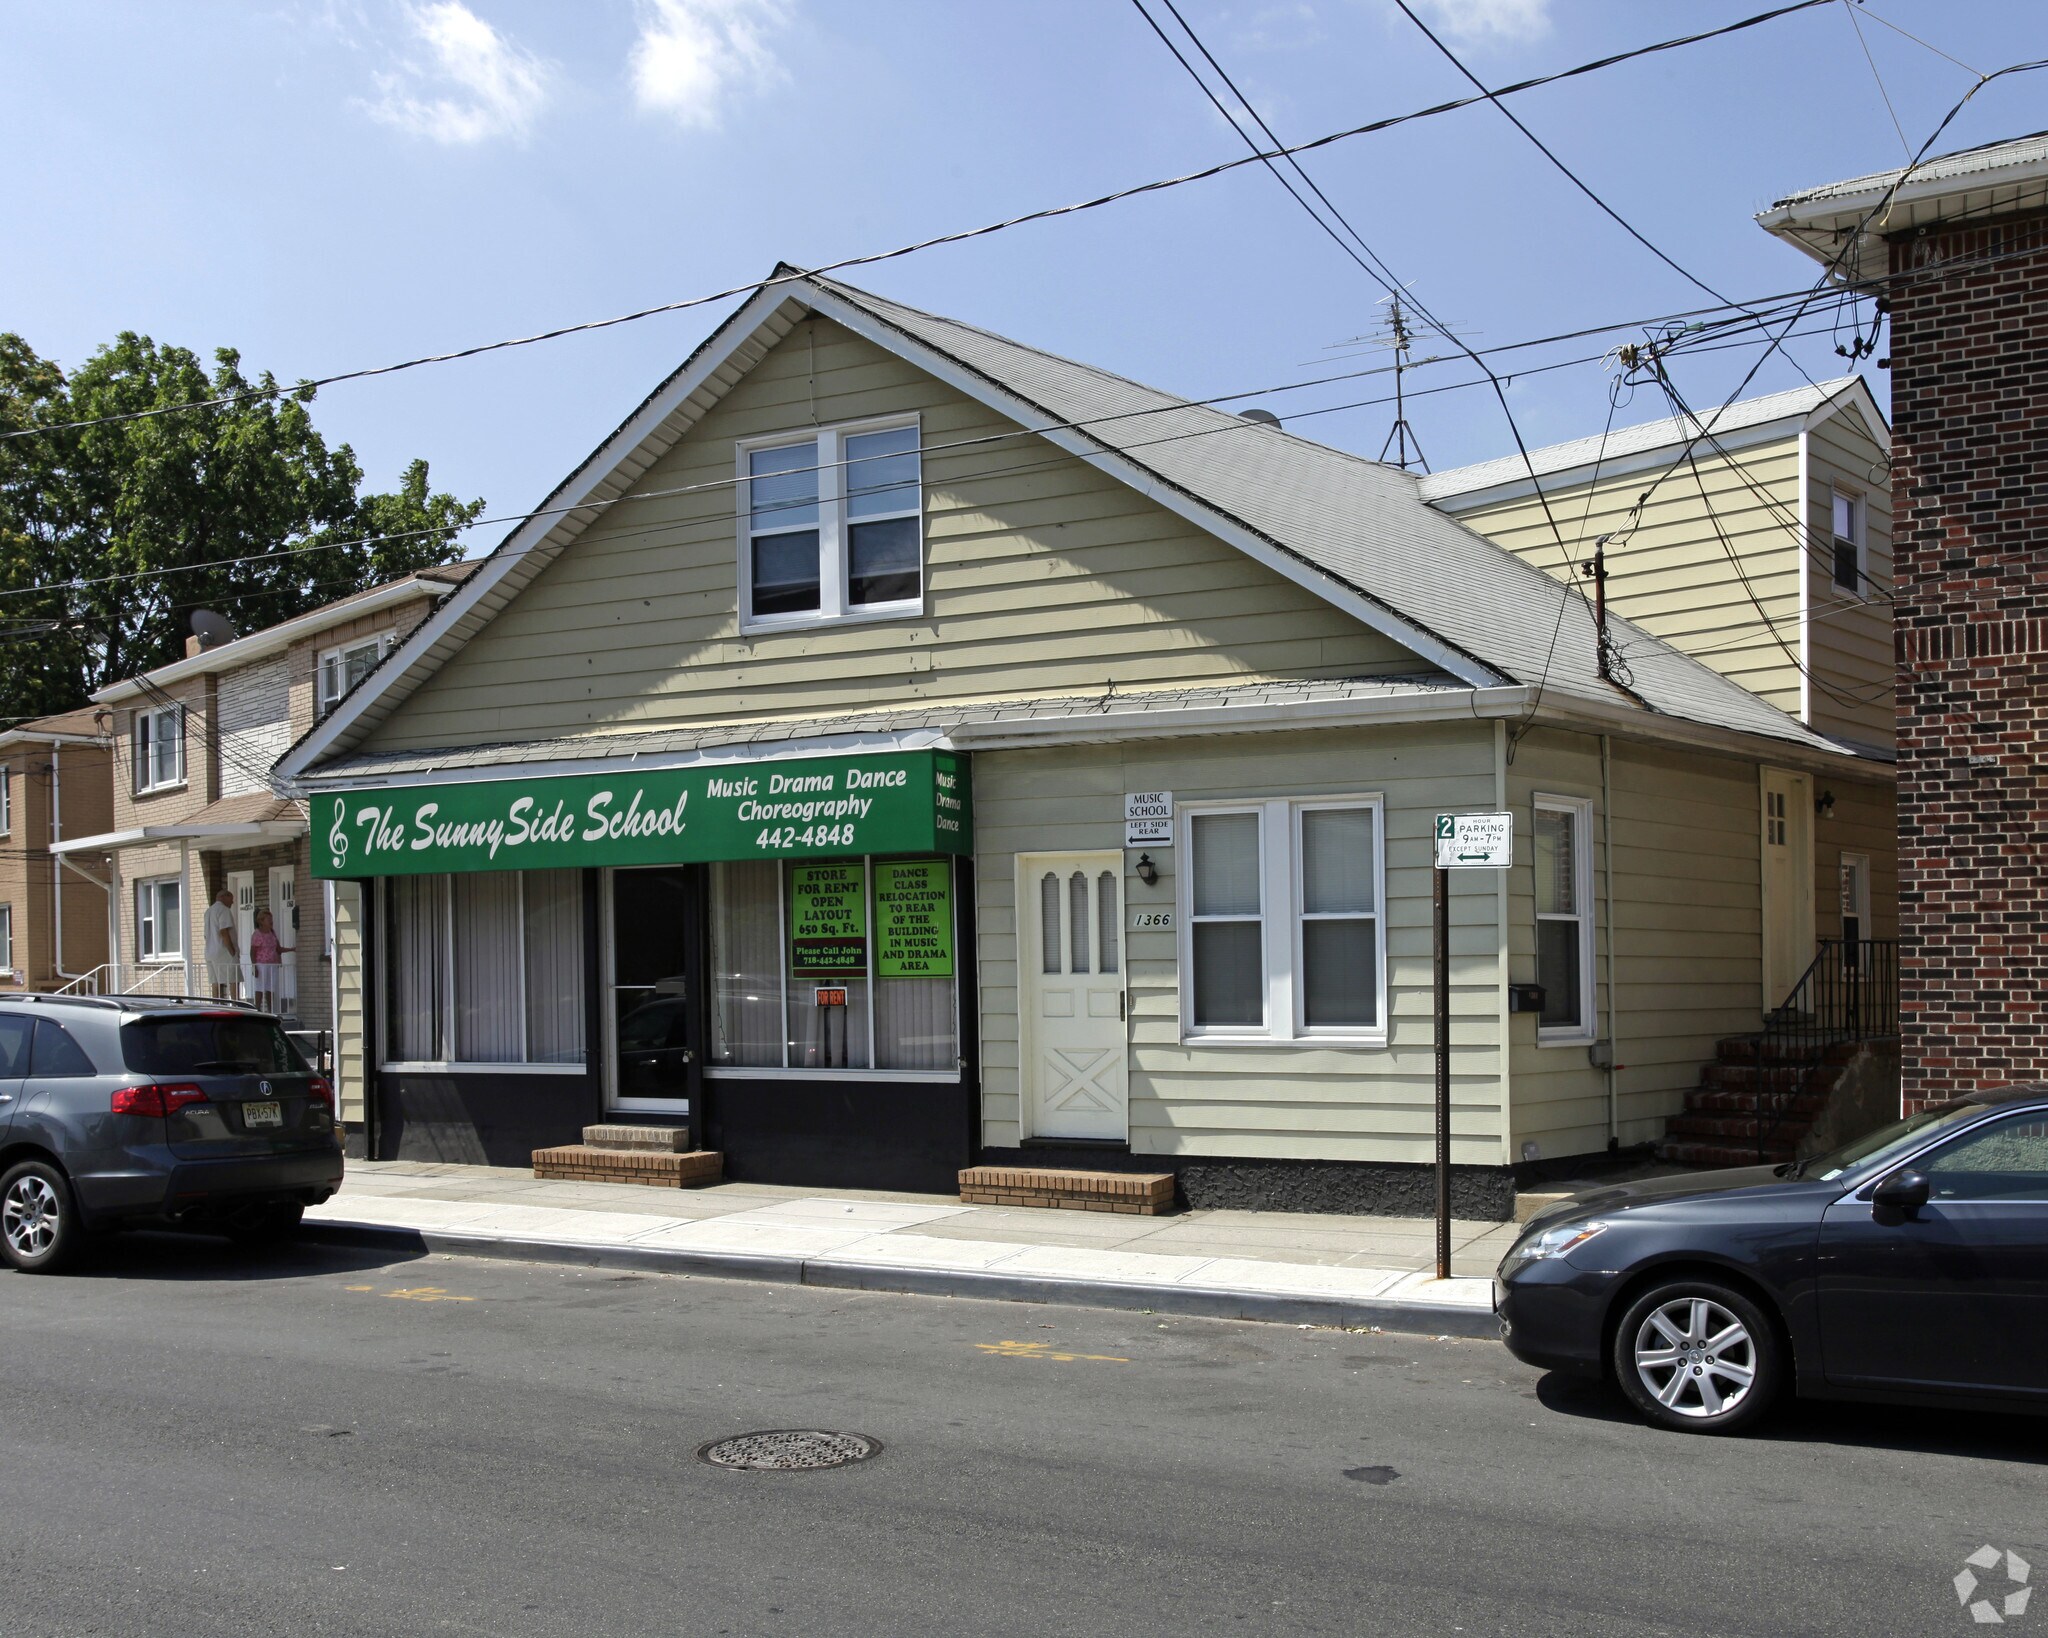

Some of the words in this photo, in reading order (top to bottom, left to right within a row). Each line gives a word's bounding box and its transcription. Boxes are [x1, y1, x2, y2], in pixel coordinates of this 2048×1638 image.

[706, 776, 758, 799] Music
[769, 774, 834, 795] Drama
[845, 769, 907, 790] Dance
[935, 771, 957, 789] Music
[936, 792, 961, 810] Drama
[1133, 793, 1164, 805] MUSIC
[737, 793, 873, 822] Choreography
[1129, 805, 1168, 817] SCHOOL
[356, 805, 405, 856] The
[582, 788, 689, 842] School
[936, 814, 959, 832] Dance
[1441, 817, 1452, 837] 2
[1459, 824, 1504, 833] PARKING
[755, 823, 855, 849] 442-4848
[1474, 845, 1499, 853] SUNDAY
[807, 869, 847, 882] STORE
[892, 868, 929, 879] DANCE
[797, 884, 821, 895] FOR
[824, 882, 859, 894] RENT
[894, 879, 928, 890] CLASS
[811, 896, 844, 908] OPEN
[879, 890, 946, 902] RELOCATION
[889, 903, 902, 913] TO
[905, 902, 936, 913] REAR
[804, 909, 852, 921] LAYOUT
[892, 915, 907, 925] OF
[908, 914, 930, 924] THE
[1136, 914, 1171, 926] 1366
[799, 924, 818, 935] 650
[821, 923, 839, 936] Sq.
[842, 922, 859, 934] Ft.
[888, 925, 939, 936] BUILDING
[890, 938, 901, 948] IN
[904, 937, 938, 947] MUSIC
[796, 947, 821, 955] Please
[822, 947, 839, 955] Call
[841, 947, 862, 955] John
[882, 950, 905, 959] AND
[907, 949, 947, 959] DRAMA
[803, 956, 855, 965] 718-442-4848
[900, 961, 929, 971] AREA
[817, 990, 829, 1006] FOR
[829, 990, 845, 1005] RENT
